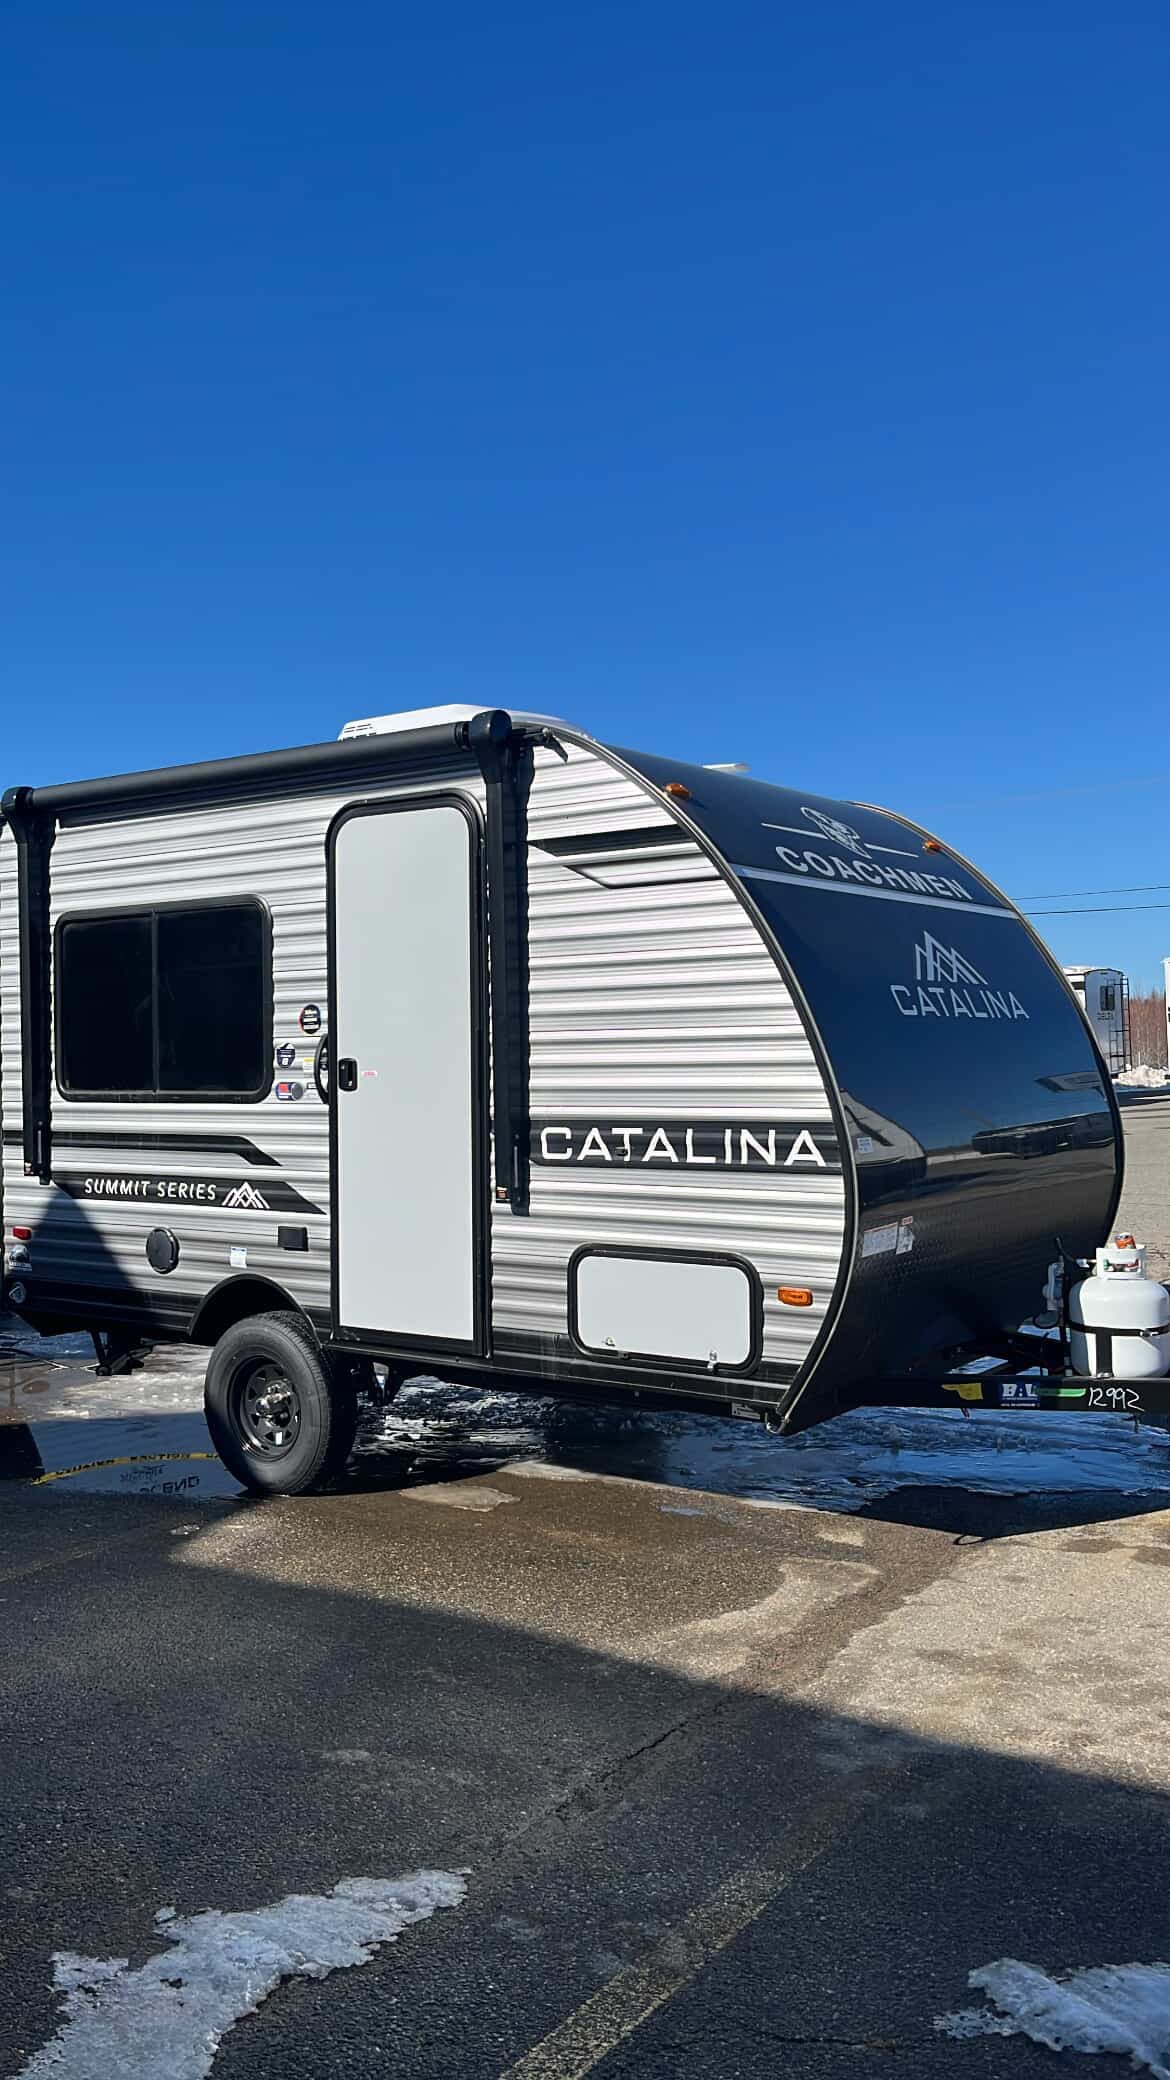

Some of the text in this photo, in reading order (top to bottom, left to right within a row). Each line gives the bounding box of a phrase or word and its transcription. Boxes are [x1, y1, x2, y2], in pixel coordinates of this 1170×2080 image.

[776, 846, 973, 900] COACHMEN
[890, 984, 1030, 1019] CATALINA
[540, 1126, 827, 1166] CATALINA
[84, 1178, 217, 1201] SUMMIT SERIES
[1088, 1387, 1144, 1412] 12992
